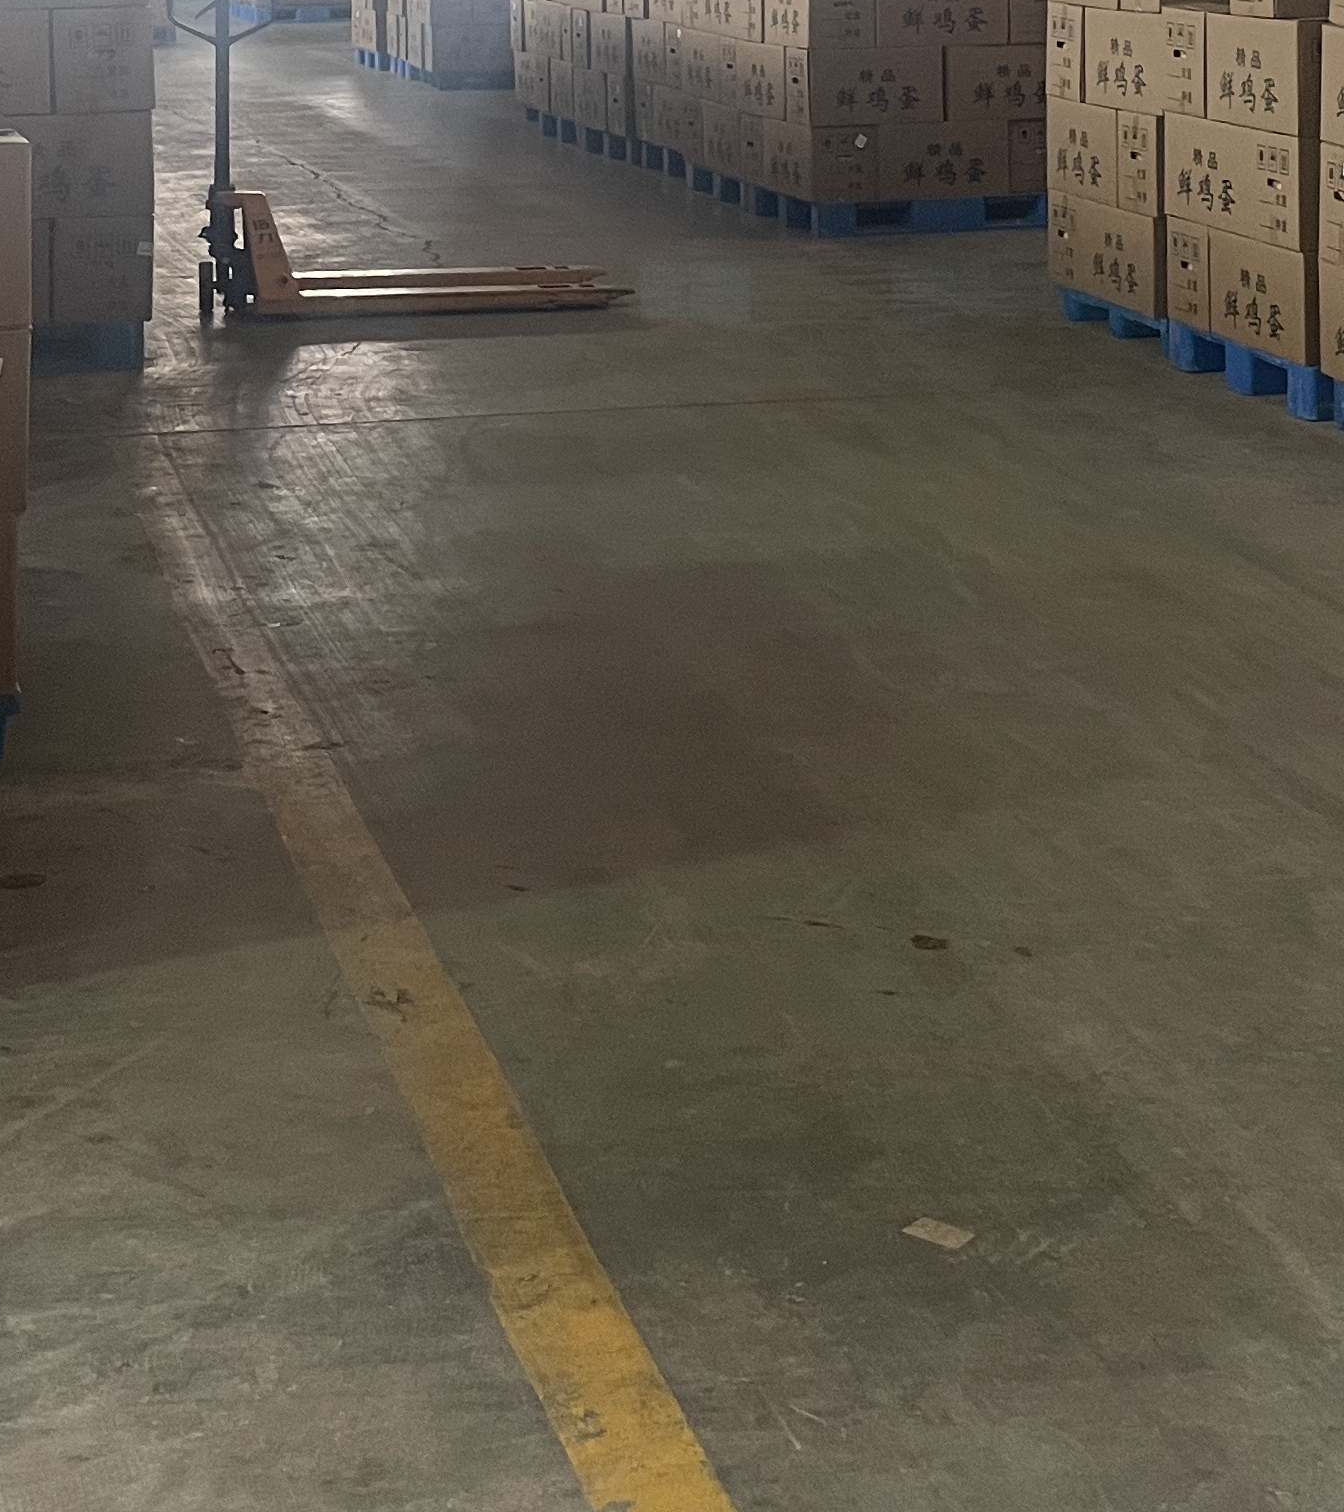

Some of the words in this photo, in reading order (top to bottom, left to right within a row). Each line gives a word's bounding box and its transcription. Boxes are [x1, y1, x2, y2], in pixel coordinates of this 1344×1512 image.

[902, 4, 988, 35] 鲜鸡蛋
[1235, 47, 1262, 70] 精品
[1096, 59, 1147, 97] 鲜鸡蛋
[1219, 70, 1279, 114] 鲜鸡蛋
[835, 85, 920, 113] 鲜鸡蛋
[1192, 147, 1218, 171] 精品
[1177, 168, 1237, 215] 鲜鸡蛋
[1239, 268, 1267, 295] 精品
[1224, 290, 1285, 341] 鲜鸡蛋
